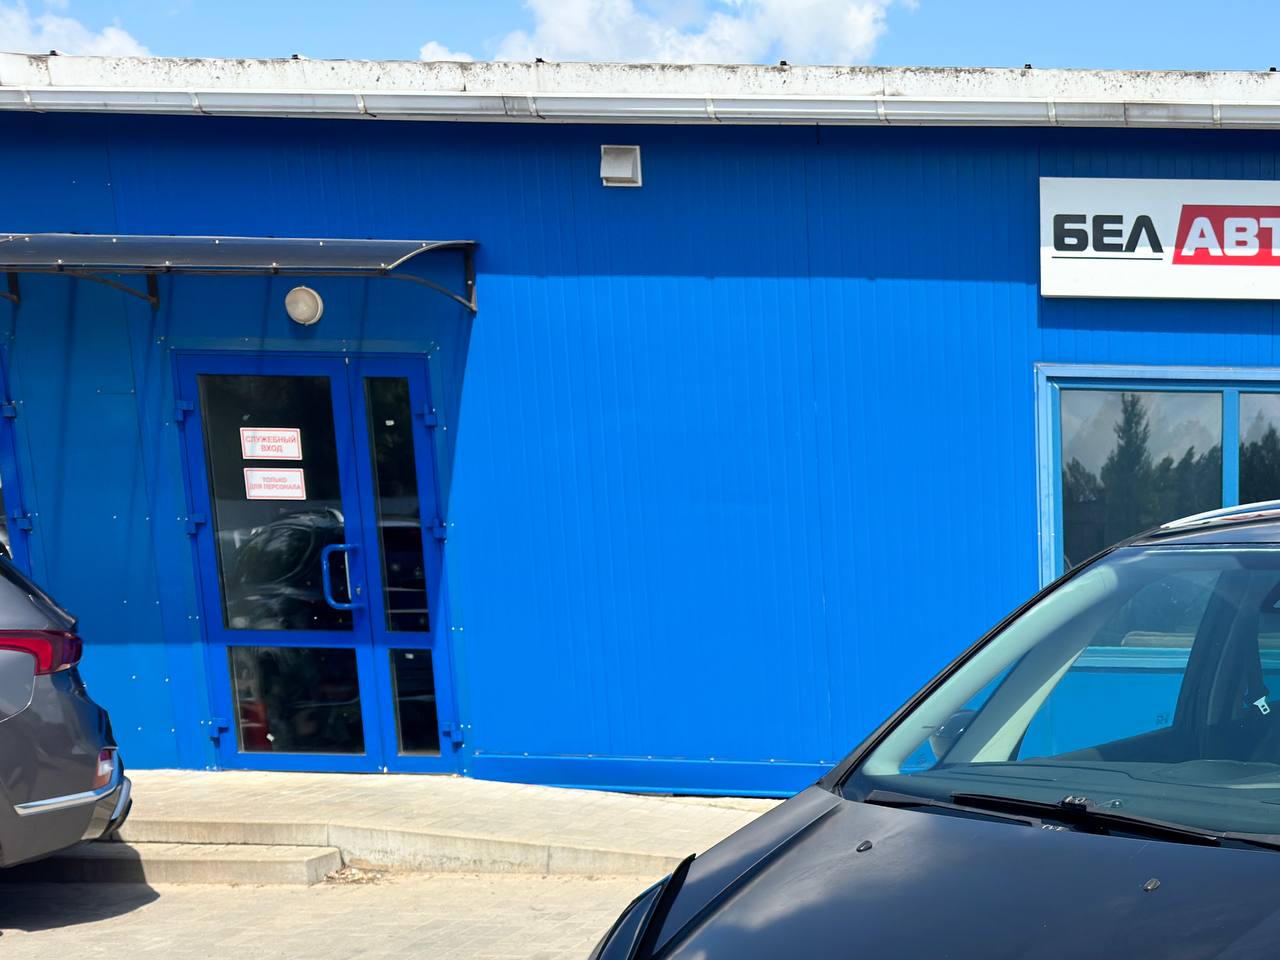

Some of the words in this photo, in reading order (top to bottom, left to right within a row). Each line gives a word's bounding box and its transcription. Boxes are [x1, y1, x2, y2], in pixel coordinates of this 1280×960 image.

[1052, 214, 1163, 253] БЕЛ
[246, 435, 296, 444] СЛУЖЕБНЫЙ
[261, 444, 283, 453] ВХОД
